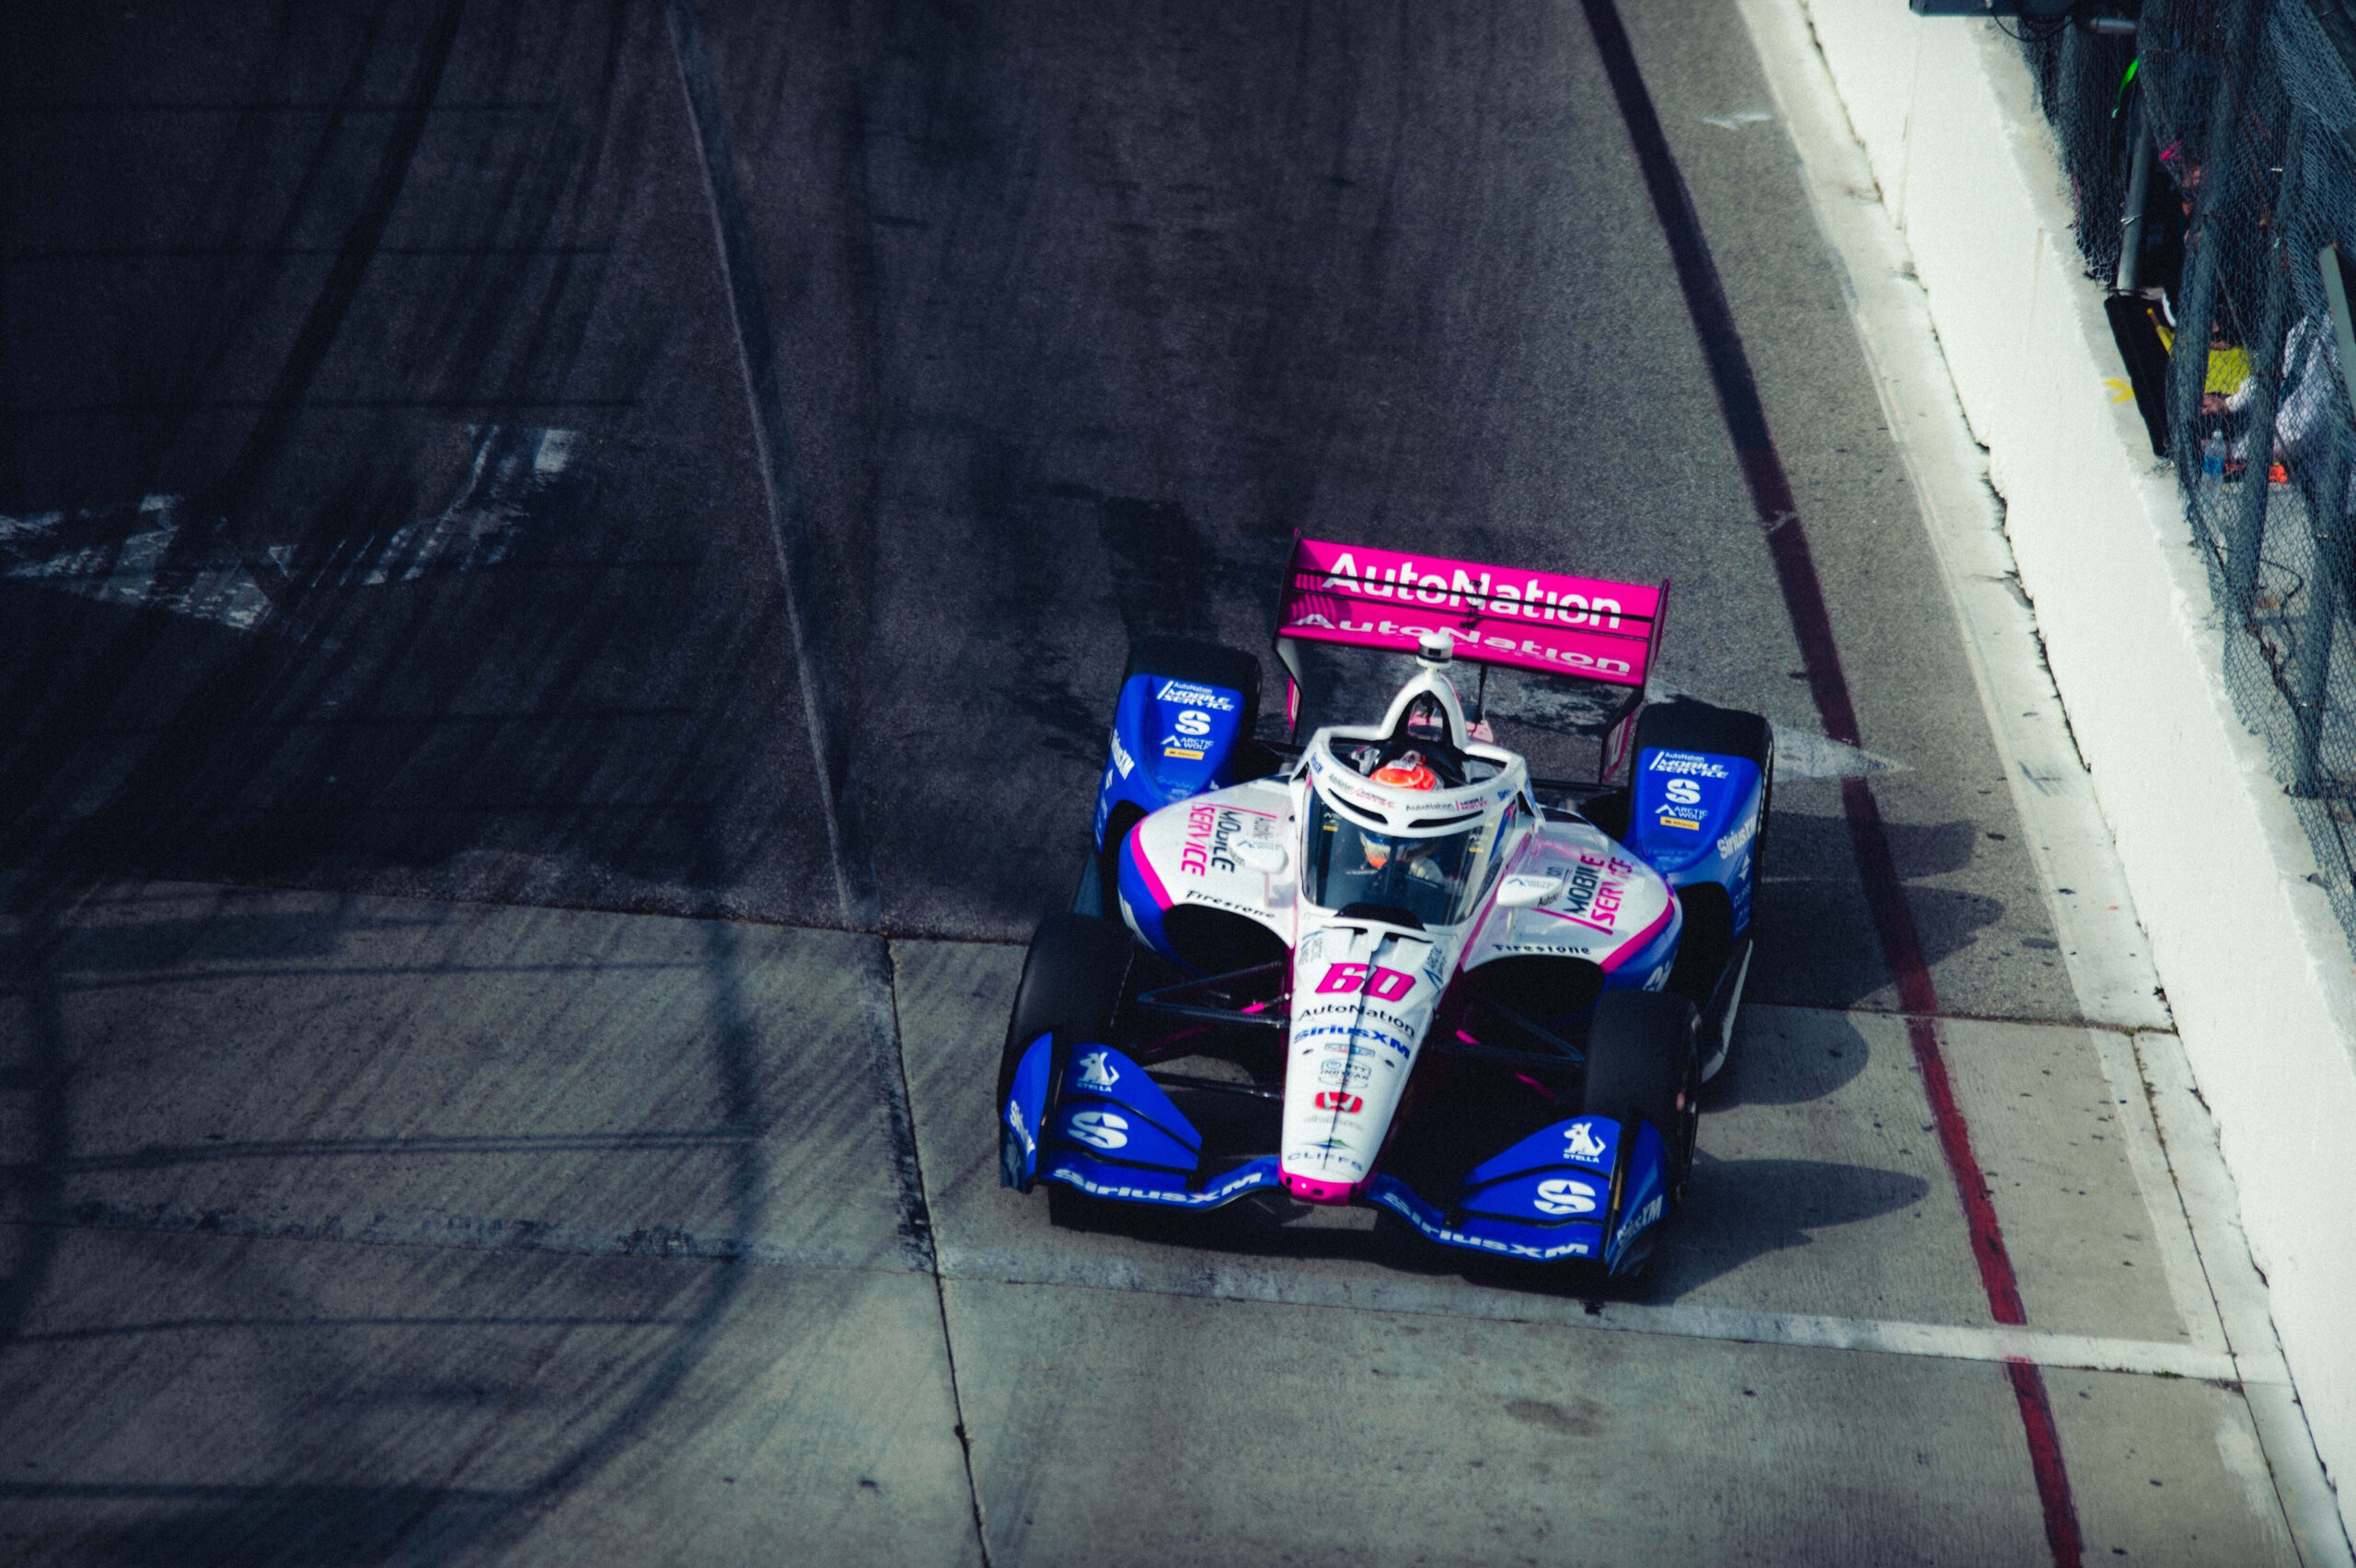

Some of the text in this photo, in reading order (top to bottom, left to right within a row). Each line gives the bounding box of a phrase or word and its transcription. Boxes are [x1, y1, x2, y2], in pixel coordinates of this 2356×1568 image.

[1322, 552, 1622, 629] AutoNation
[1293, 613, 1630, 674] AutoNation
[1173, 682, 1213, 695] AutoNation
[1665, 752, 1705, 764] AutoNation
[1181, 805, 1215, 877] SERVICE
[1563, 854, 1605, 917] MOBILE
[1185, 889, 1276, 918] Firestone
[1491, 943, 1591, 955] Firestone
[1315, 963, 1416, 1003] 60
[1299, 1004, 1415, 1039] AutoNation
[1294, 1024, 1411, 1060] SiriusXM
[1077, 1082, 1112, 1093] STELLA
[1288, 1152, 1363, 1173] CLIFFS
[1563, 1153, 1600, 1164] STELLA
